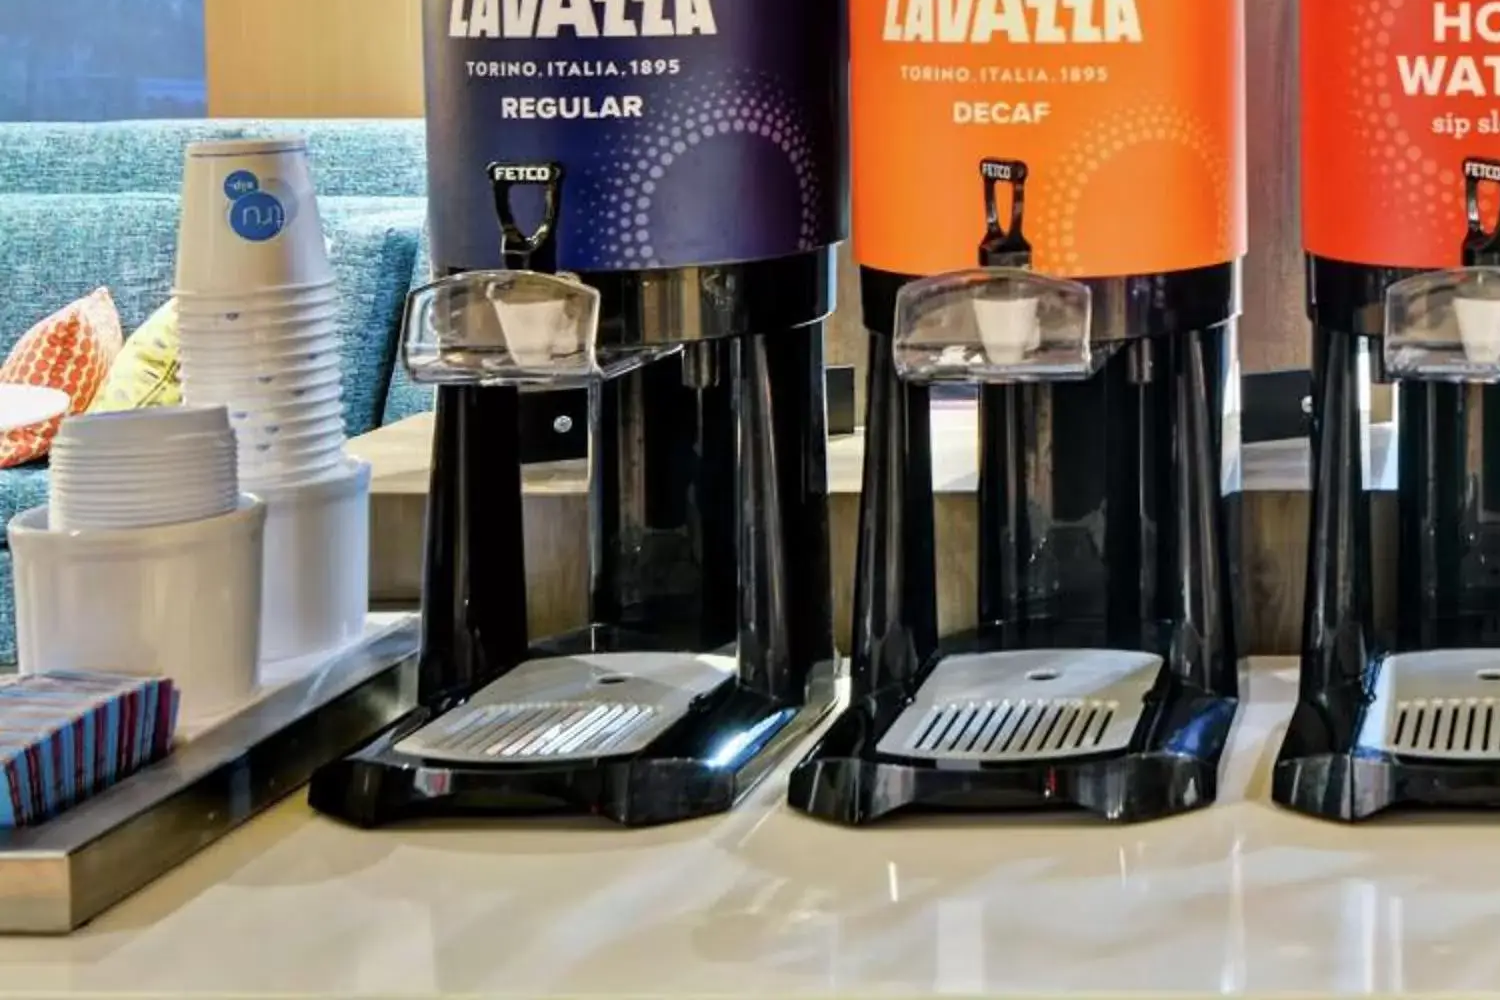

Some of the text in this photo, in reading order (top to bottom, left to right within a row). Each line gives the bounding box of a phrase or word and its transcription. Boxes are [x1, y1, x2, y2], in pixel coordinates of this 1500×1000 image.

[629, 58, 681, 76] 1895
[1060, 66, 1109, 83] 1895
[501, 96, 643, 119] REGULAR
[953, 101, 1052, 124] DECAF
[1432, 113, 1470, 139] sip
[494, 165, 551, 182] FETCO
[982, 162, 1011, 179] FETCO
